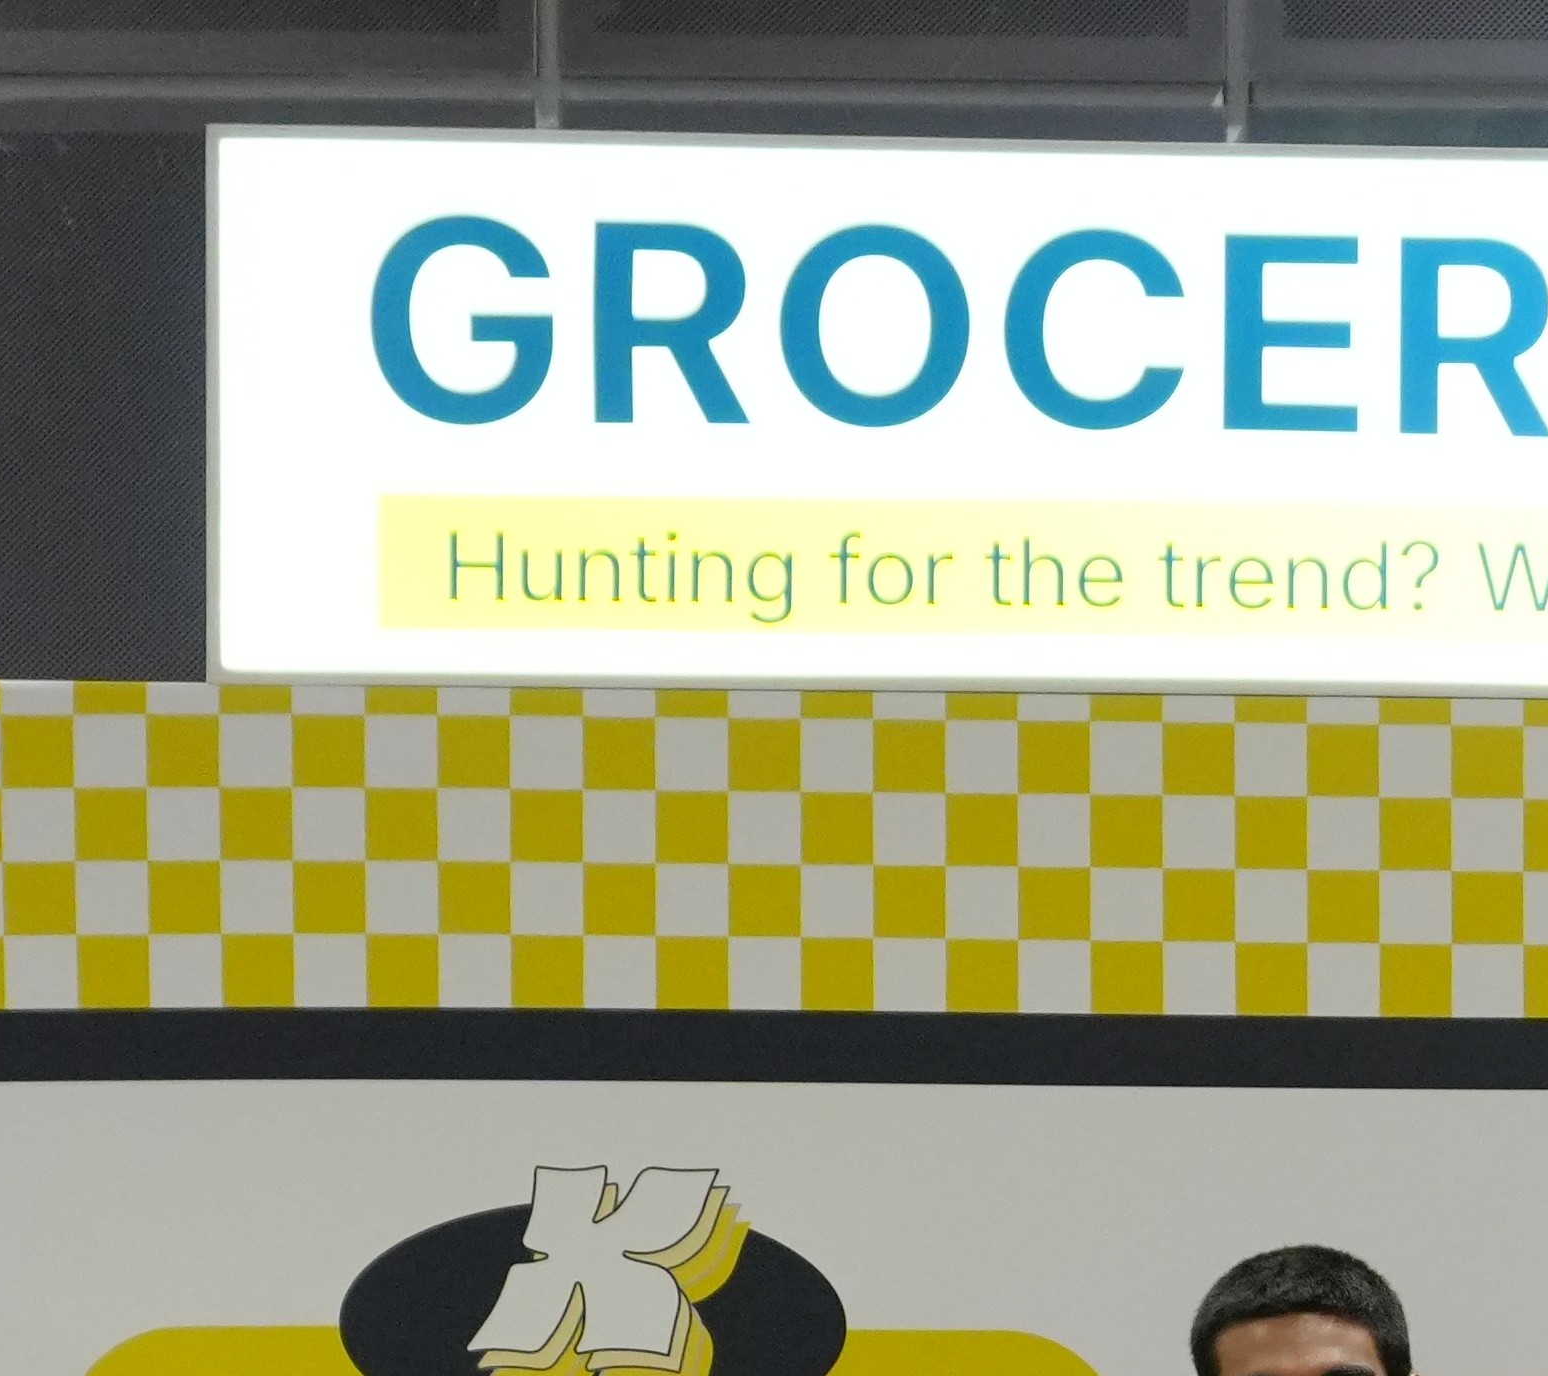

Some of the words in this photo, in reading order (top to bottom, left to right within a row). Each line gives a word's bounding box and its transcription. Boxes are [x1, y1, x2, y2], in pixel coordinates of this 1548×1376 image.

[448, 530, 794, 623] Hunting
[830, 531, 954, 605] for
[985, 536, 1124, 607] the
[1157, 540, 1440, 612] trend?
